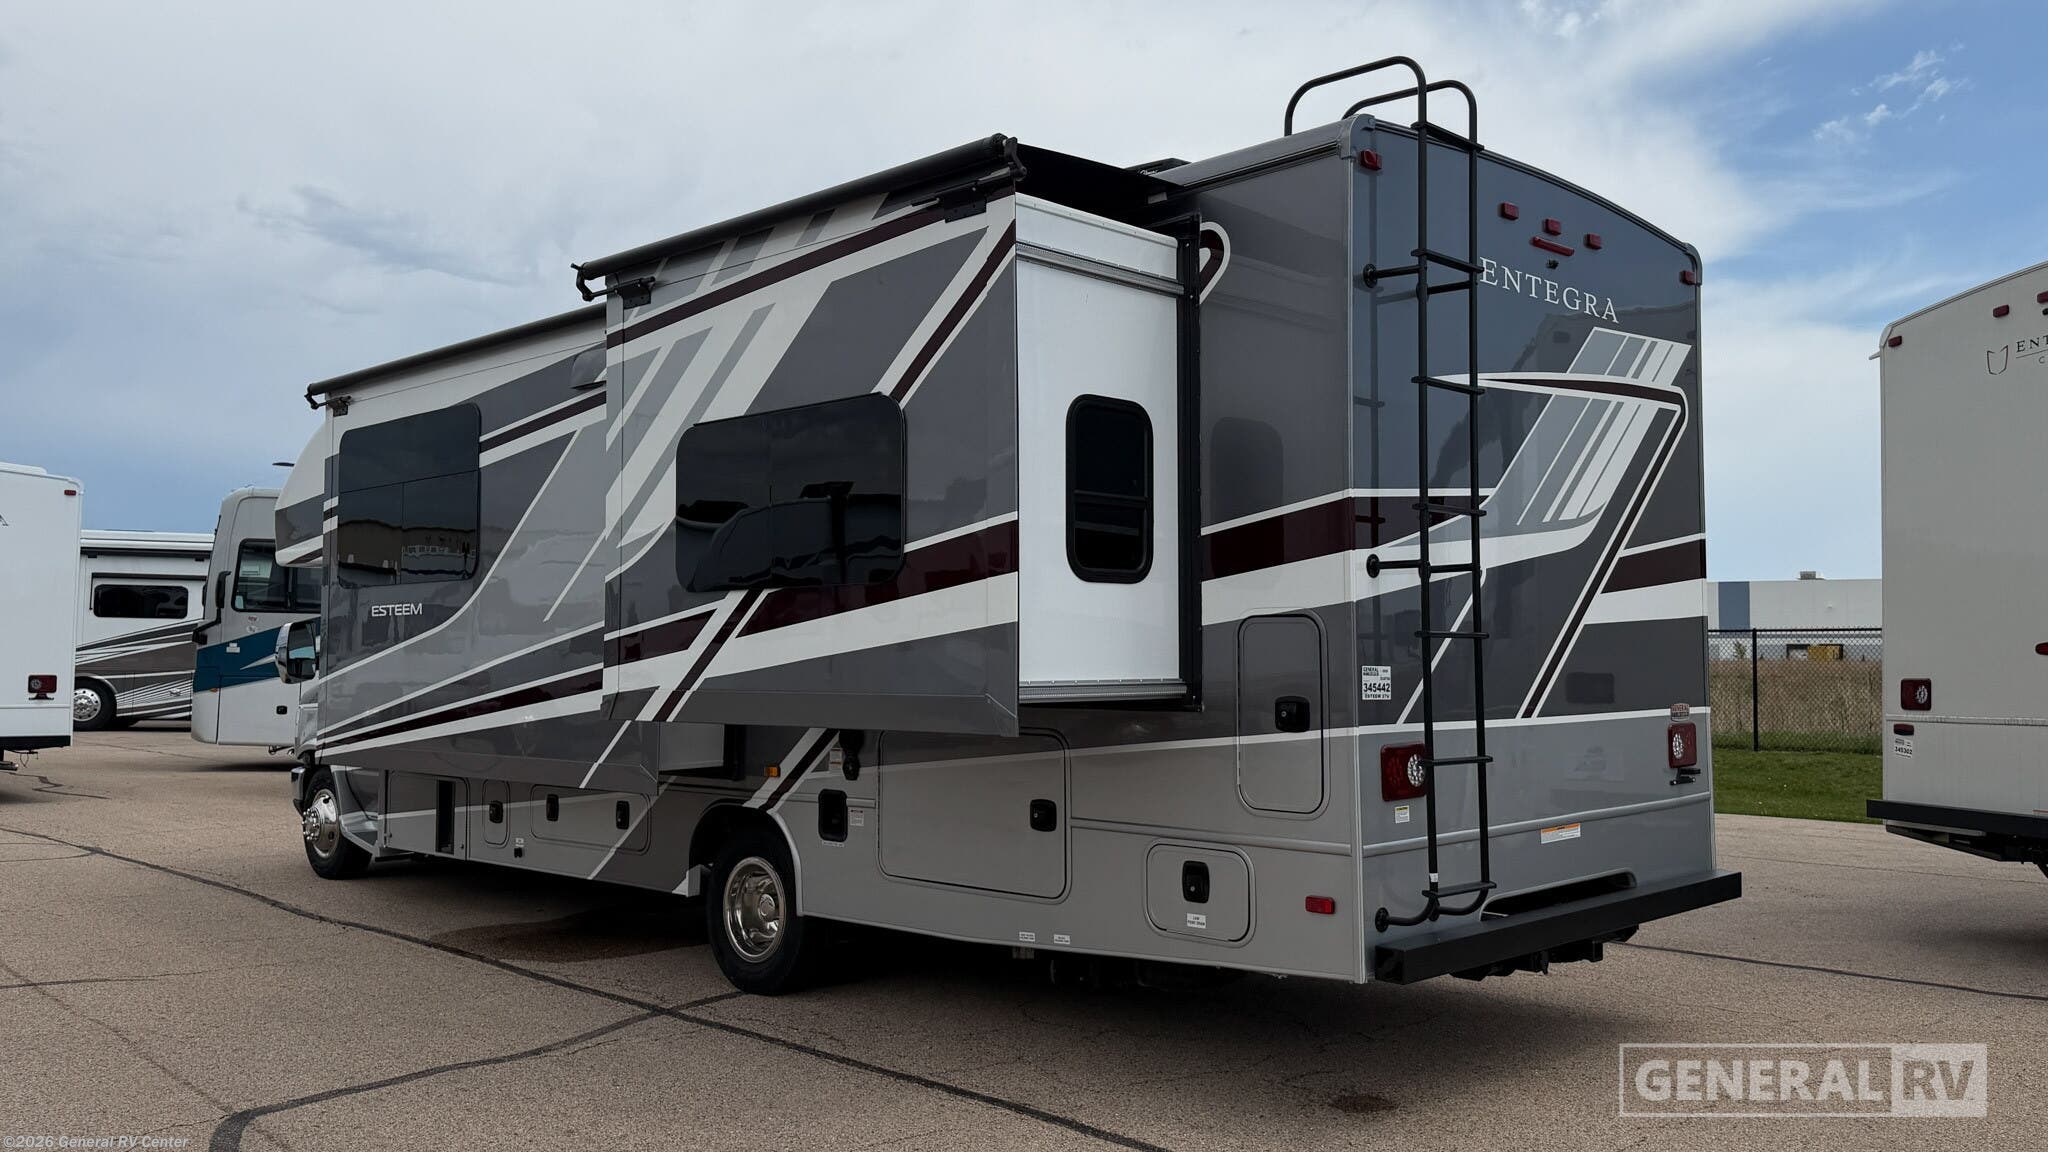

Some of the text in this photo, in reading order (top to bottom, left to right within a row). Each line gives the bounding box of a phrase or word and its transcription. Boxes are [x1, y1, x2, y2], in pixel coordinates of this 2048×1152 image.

[1480, 256, 1619, 323] ENTEGRA
[371, 603, 423, 617] ESTEEM
[1363, 683, 1390, 692] 345442
